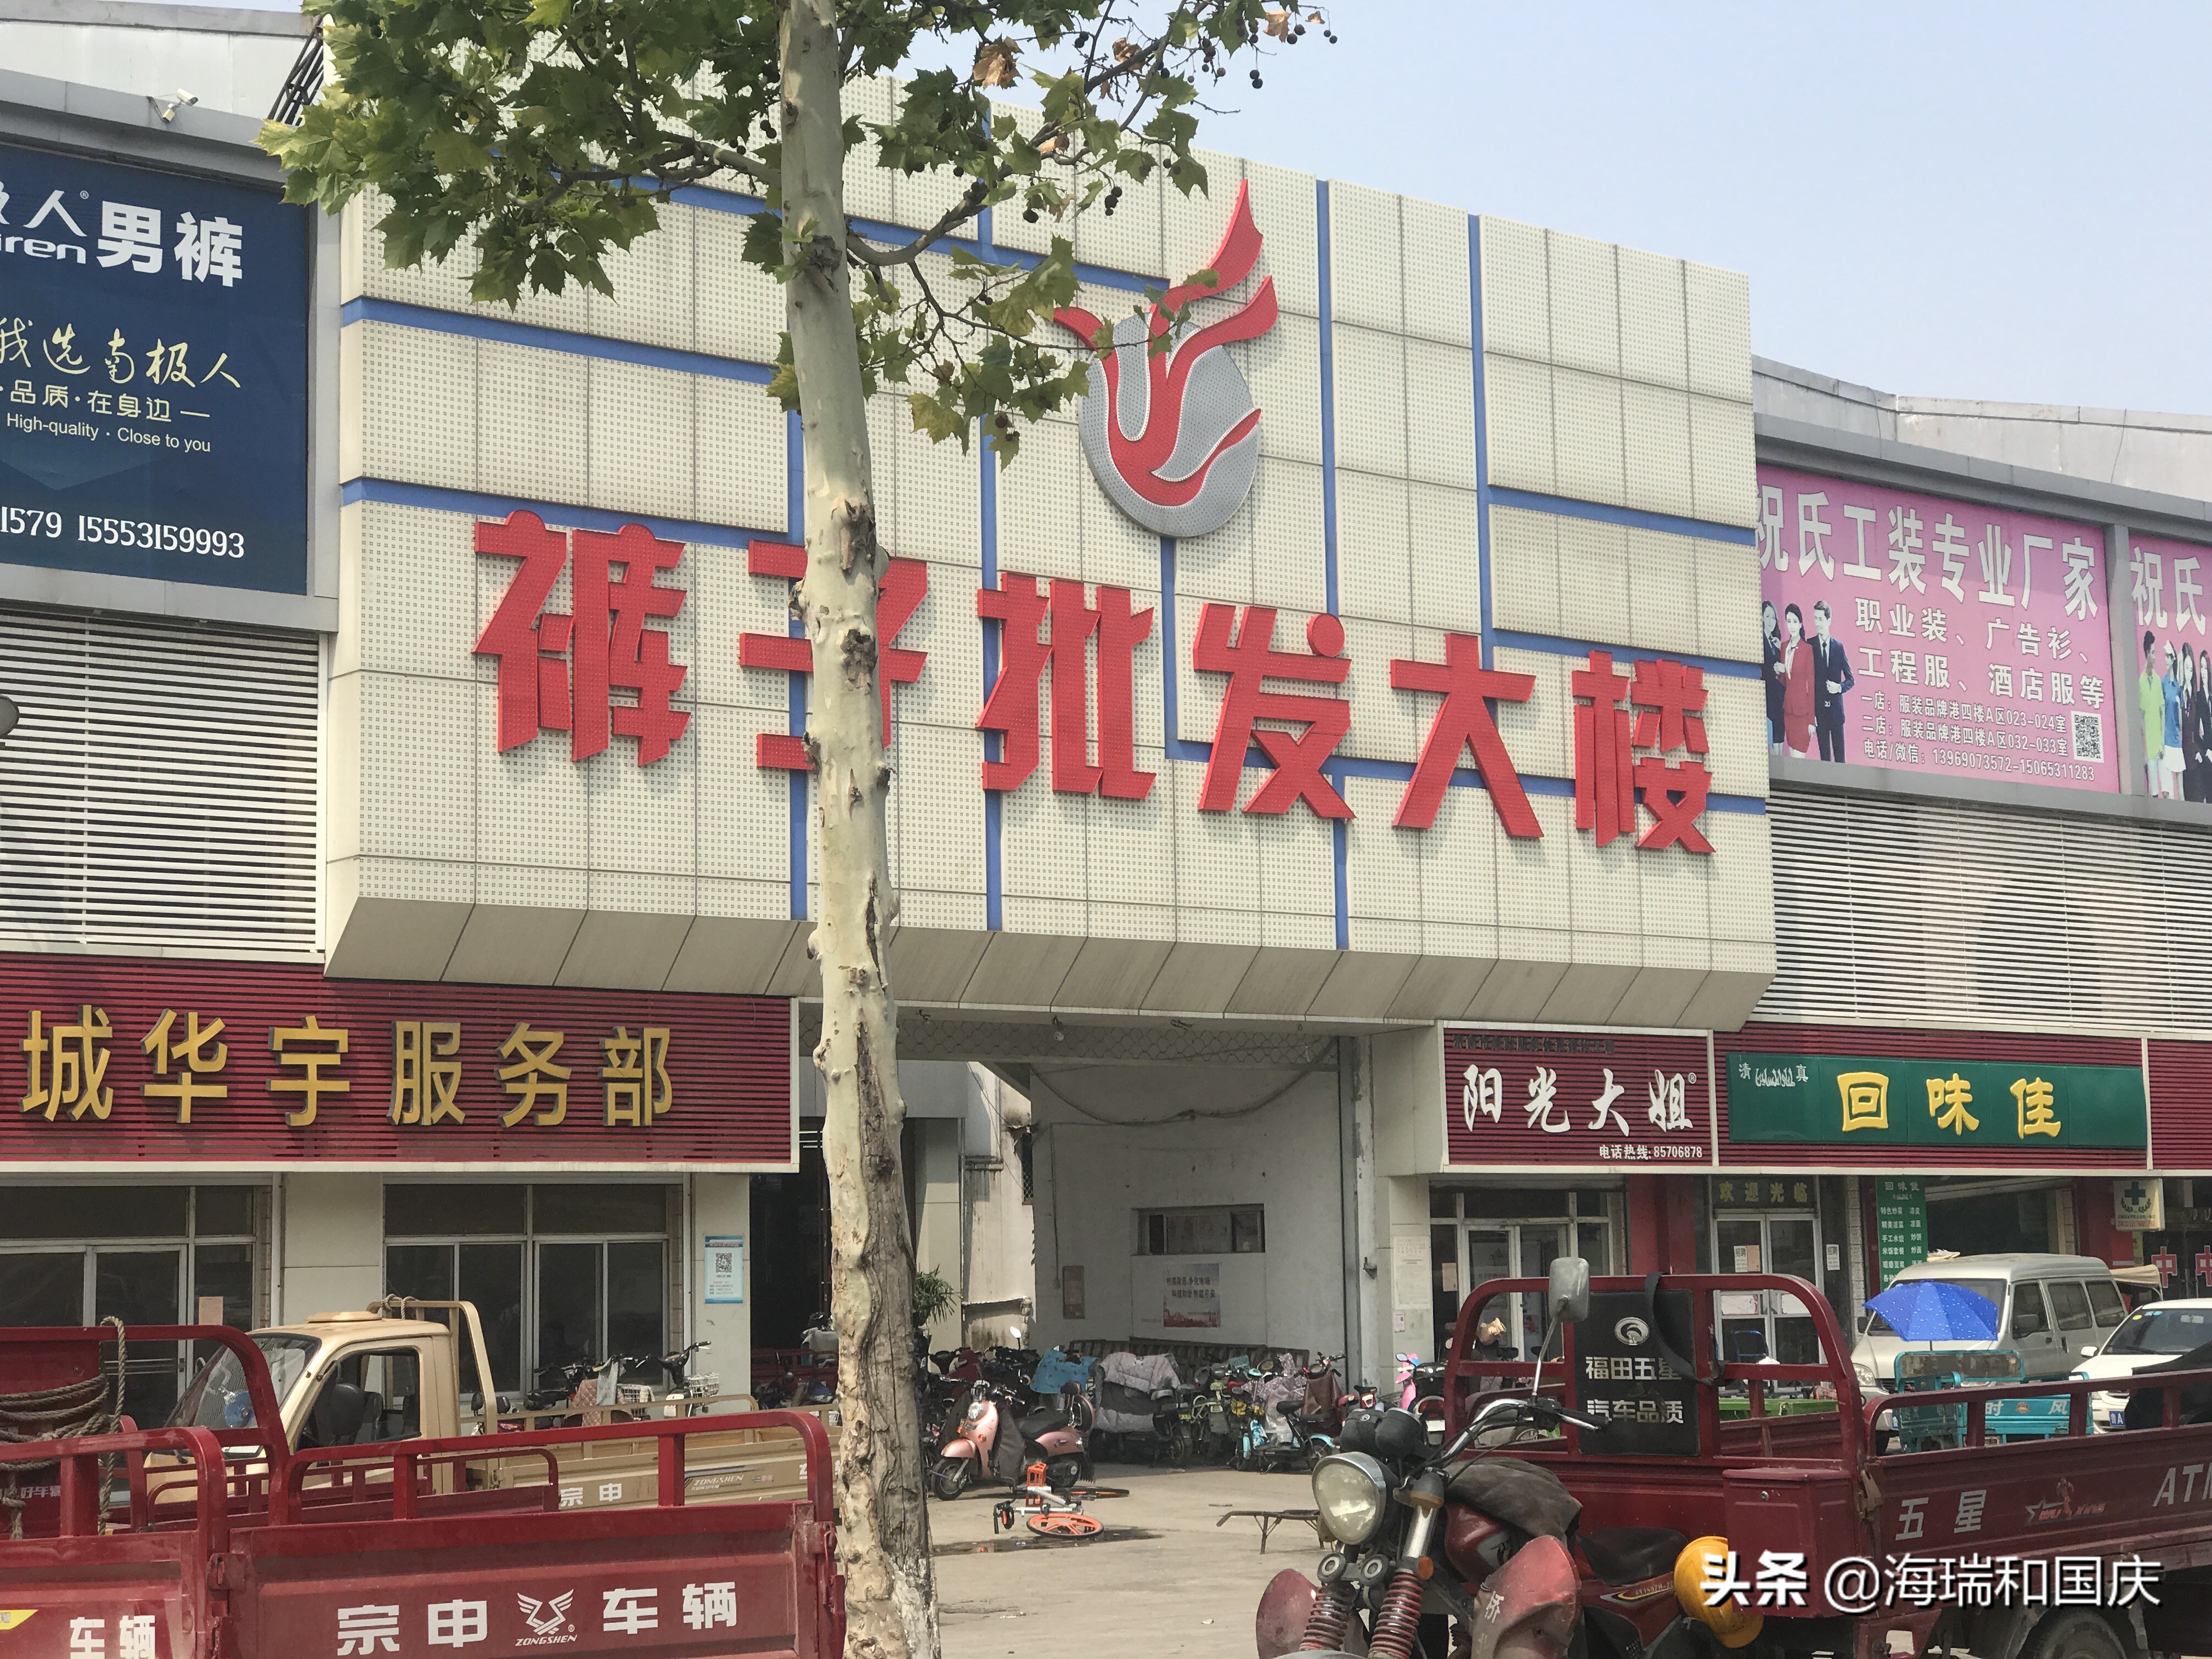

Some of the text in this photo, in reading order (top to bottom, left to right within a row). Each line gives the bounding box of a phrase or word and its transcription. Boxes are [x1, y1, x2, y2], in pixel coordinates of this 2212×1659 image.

[98, 200, 243, 288] 男裤
[7, 412, 211, 453] High-quality Close to you
[77, 515, 245, 559] 15553159993
[1757, 484, 2098, 622] 祝氏工装专业厂家
[2131, 546, 2207, 635] 祝氏
[473, 509, 1716, 855] 裤子批发大楼
[18, 1004, 674, 1127] 城华宇服务部
[1463, 1063, 1694, 1137] 阳光大姐
[1837, 1071, 2062, 1139] 回味佳
[1719, 1181, 1808, 1203] 欢迎光临
[1884, 1181, 1920, 1192] 回味佳
[1882, 1234, 1904, 1243] 手工水饺
[1585, 1356, 1682, 1380] 福田五星
[1587, 1399, 1684, 1424] 汽车品质
[1985, 1400, 2068, 1417] 时风
[560, 1482, 623, 1507] 宗申
[693, 1475, 744, 1486] ZONGSHEN
[1895, 1489, 1987, 1541] 五星
[70, 1615, 156, 1659] 车辆
[337, 1581, 737, 1656] 宗申 车辆
[515, 1633, 578, 1647] ZONGSHEN
